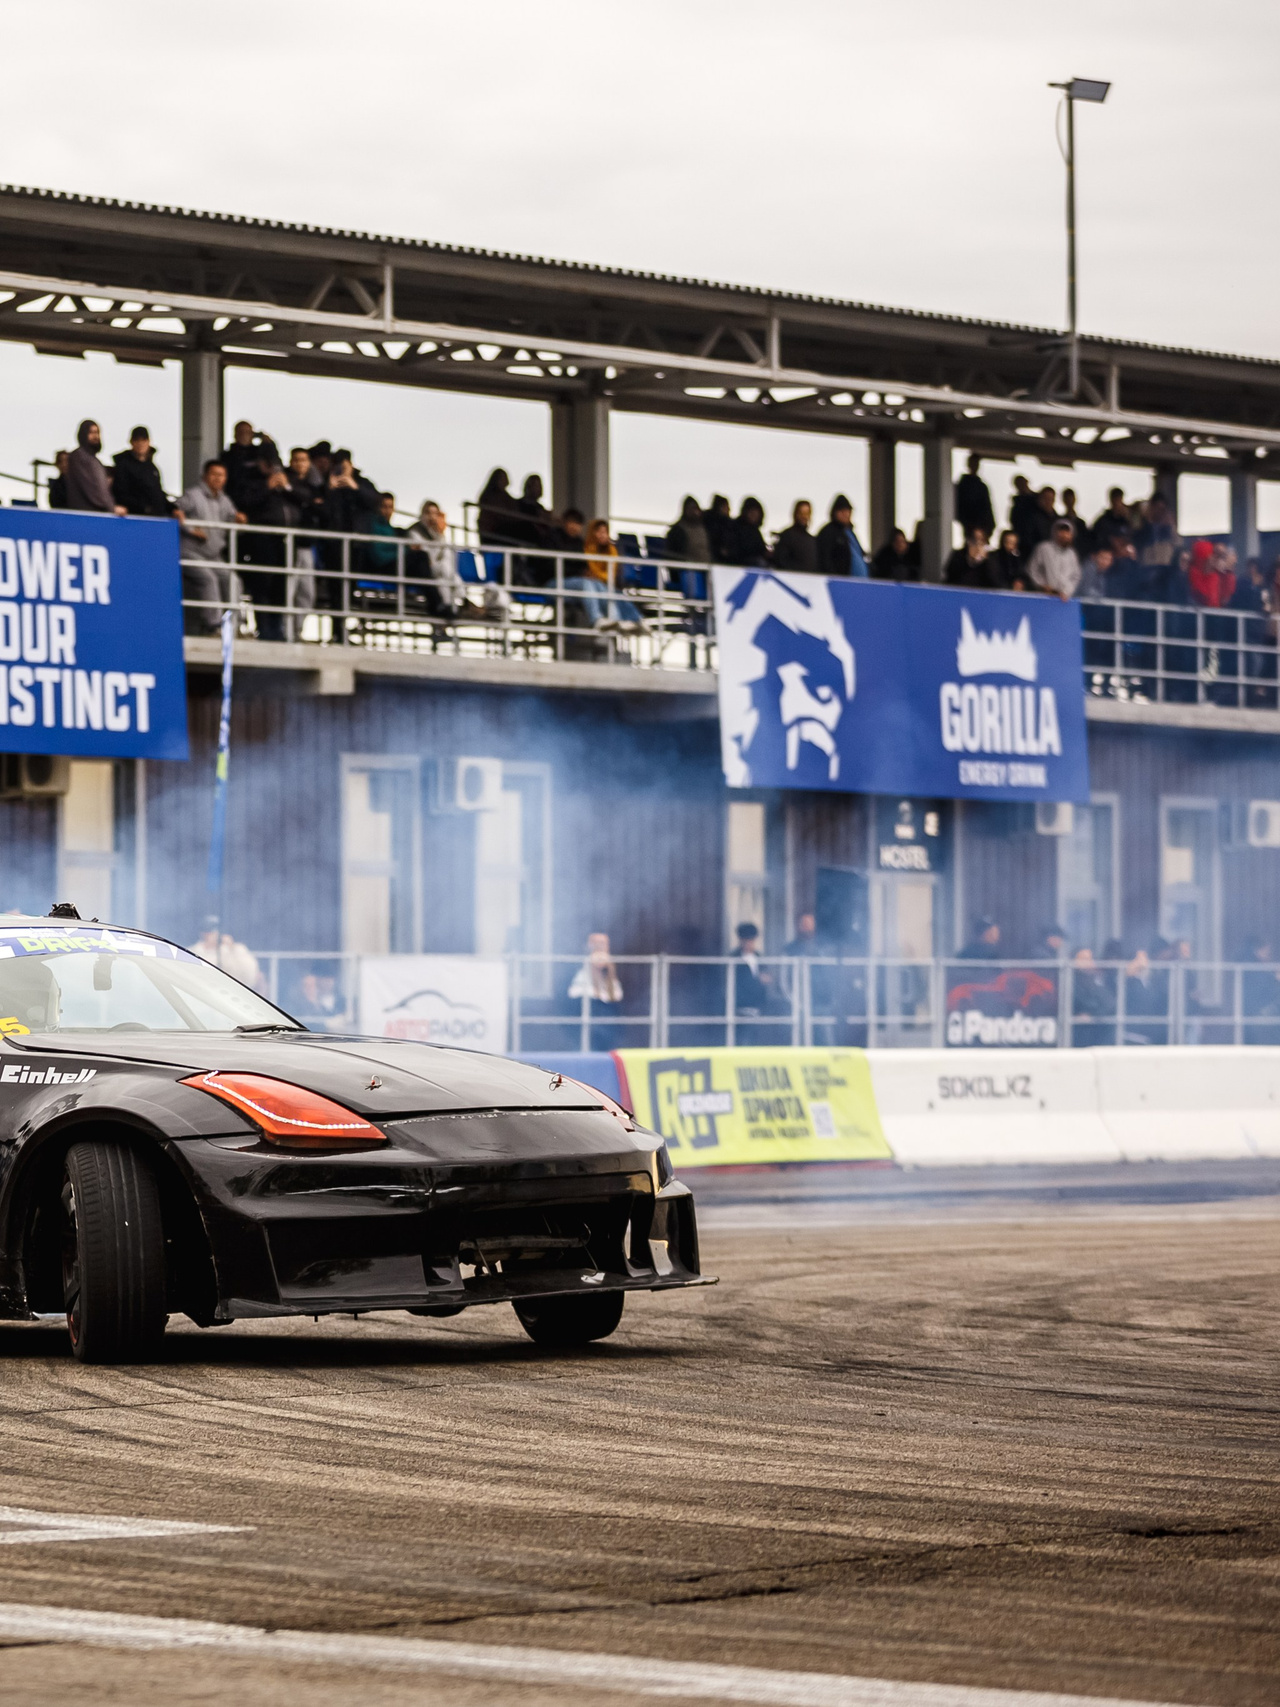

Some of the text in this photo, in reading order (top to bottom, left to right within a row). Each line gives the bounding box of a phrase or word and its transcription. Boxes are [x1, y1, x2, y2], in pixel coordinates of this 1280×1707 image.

[940, 682, 1062, 757] GORILLA
[964, 1010, 1056, 1044] Pandora
[0, 1065, 98, 1085] Einhell
